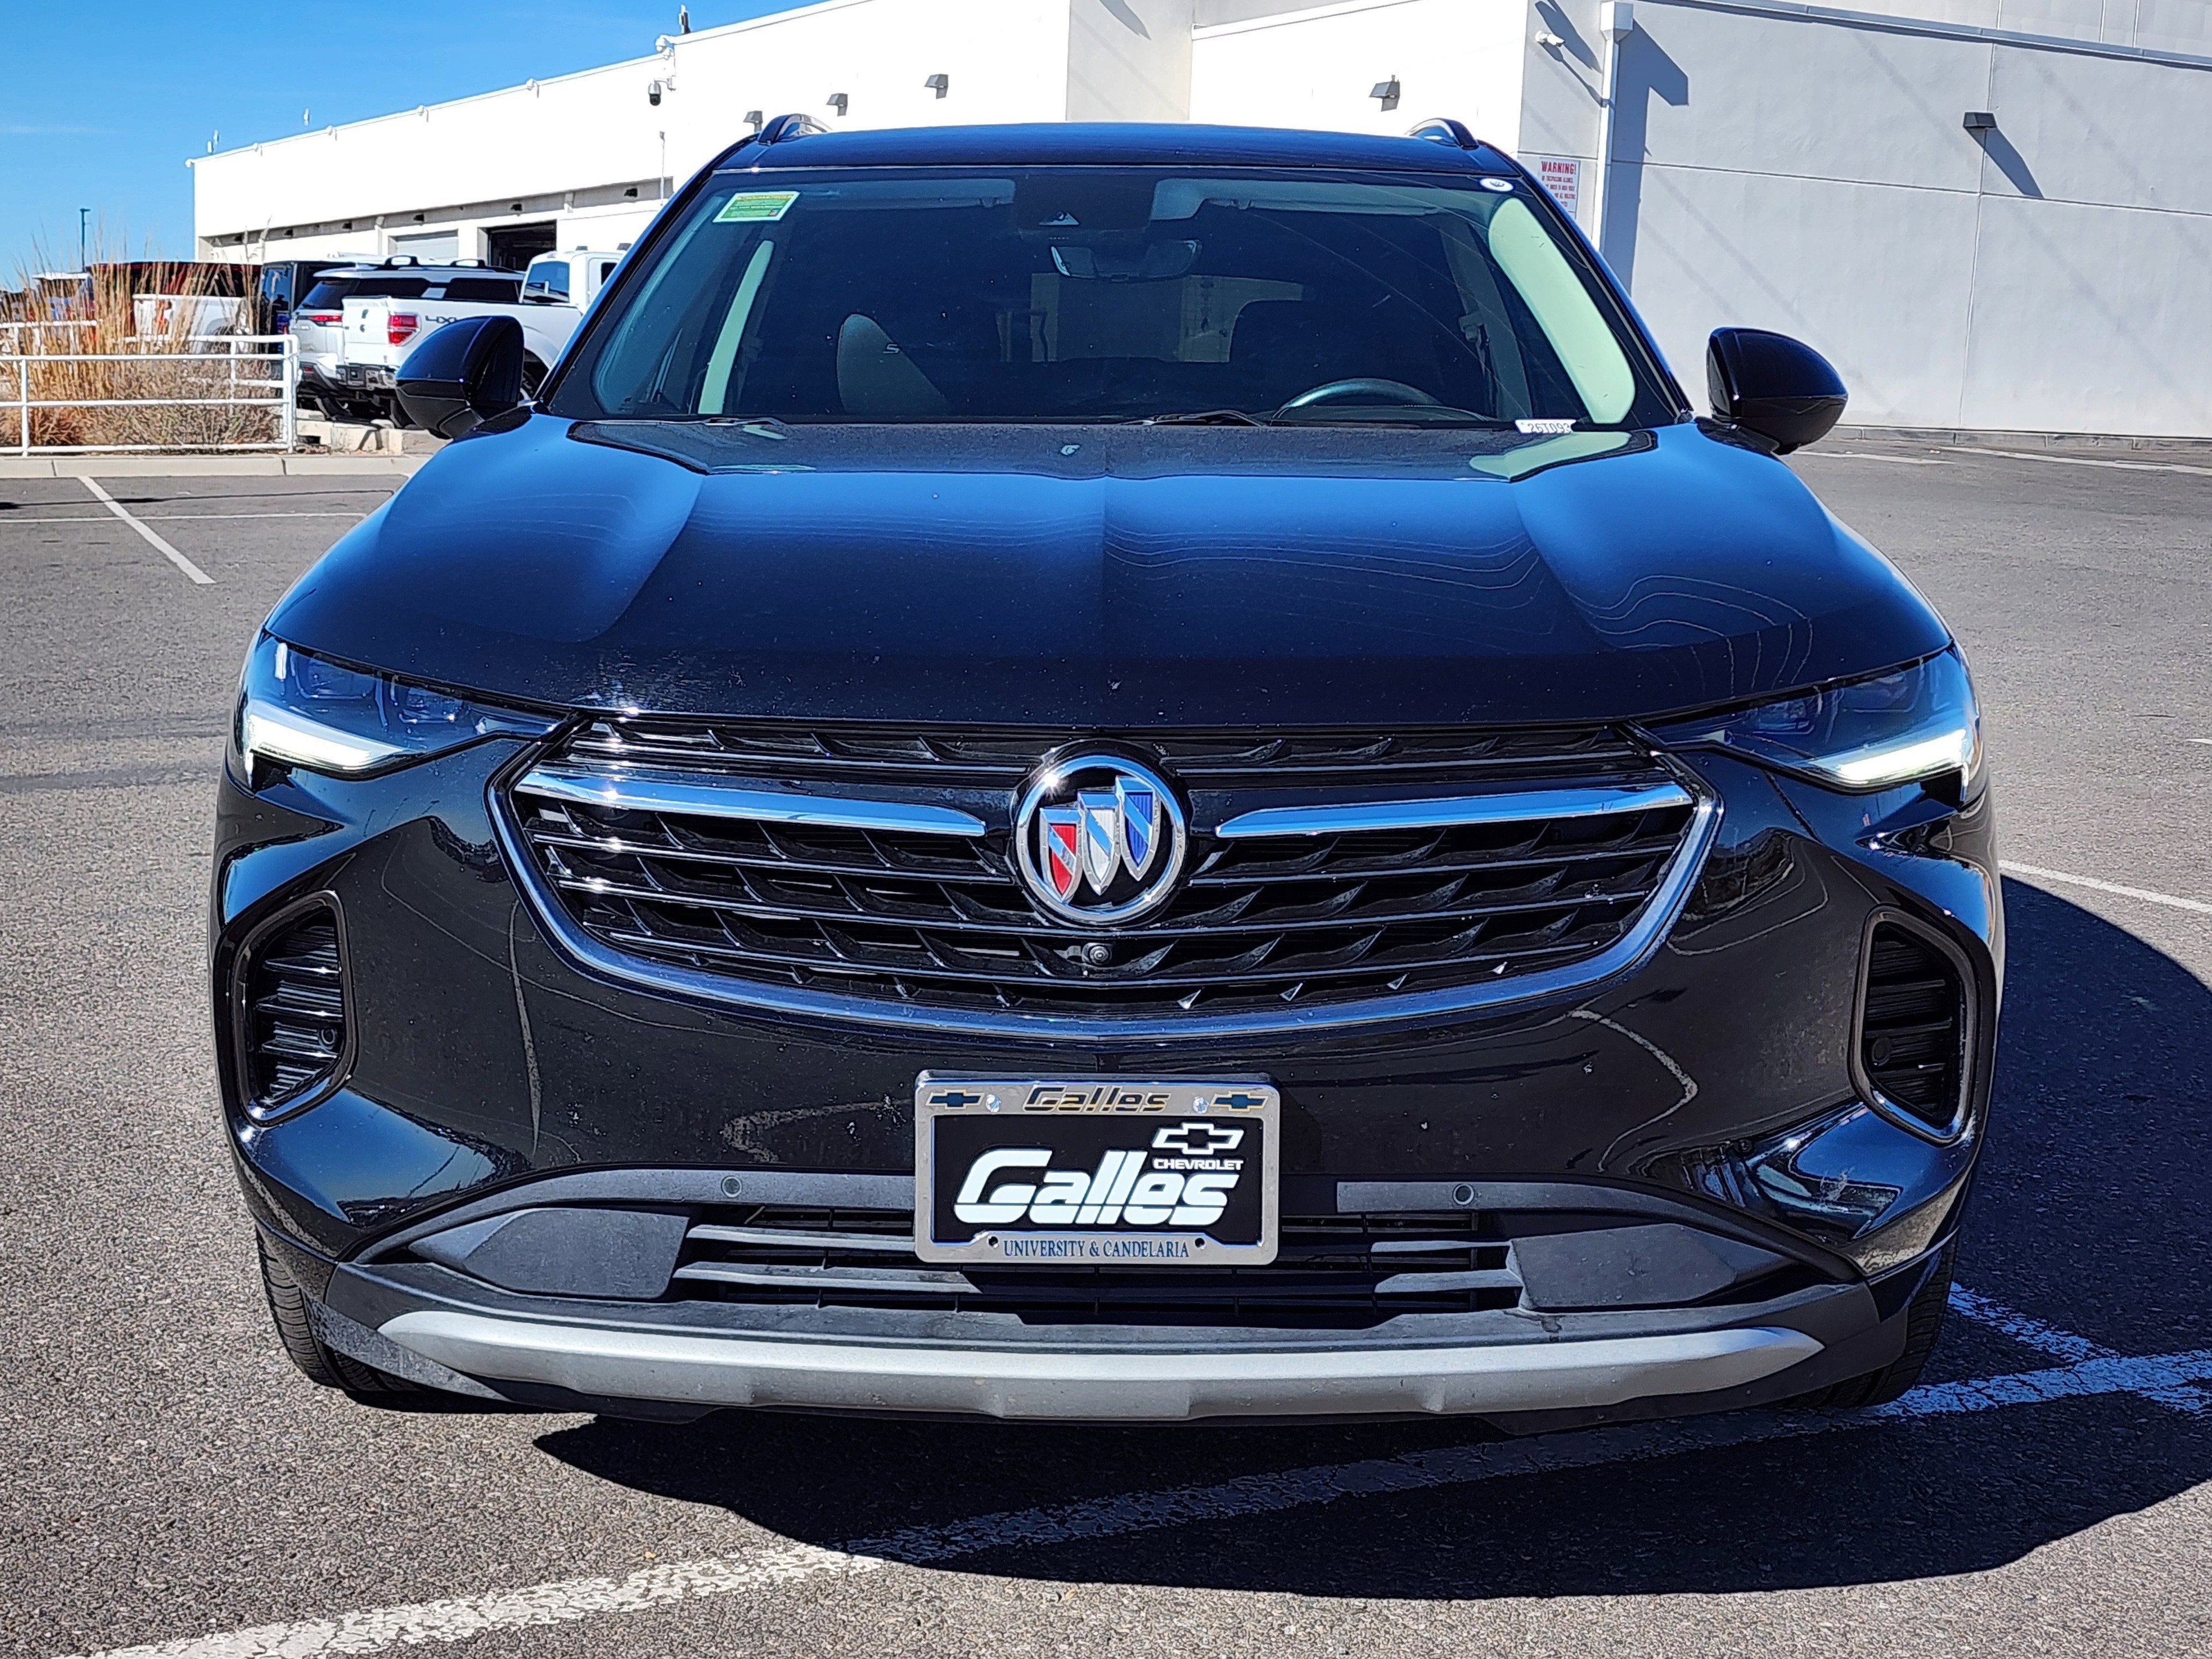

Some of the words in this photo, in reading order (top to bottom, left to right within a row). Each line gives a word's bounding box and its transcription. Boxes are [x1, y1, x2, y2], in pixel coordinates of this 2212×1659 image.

[1542, 161, 1576, 175] WARNING!
[1022, 1085, 1172, 1113] Galles
[1154, 1158, 1244, 1170] CHEVROLET
[954, 1149, 1240, 1225] Galles
[1003, 1240, 1086, 1257] UNIVERSITY
[1089, 1240, 1099, 1257] &
[1103, 1240, 1190, 1258] CANDELARIA
